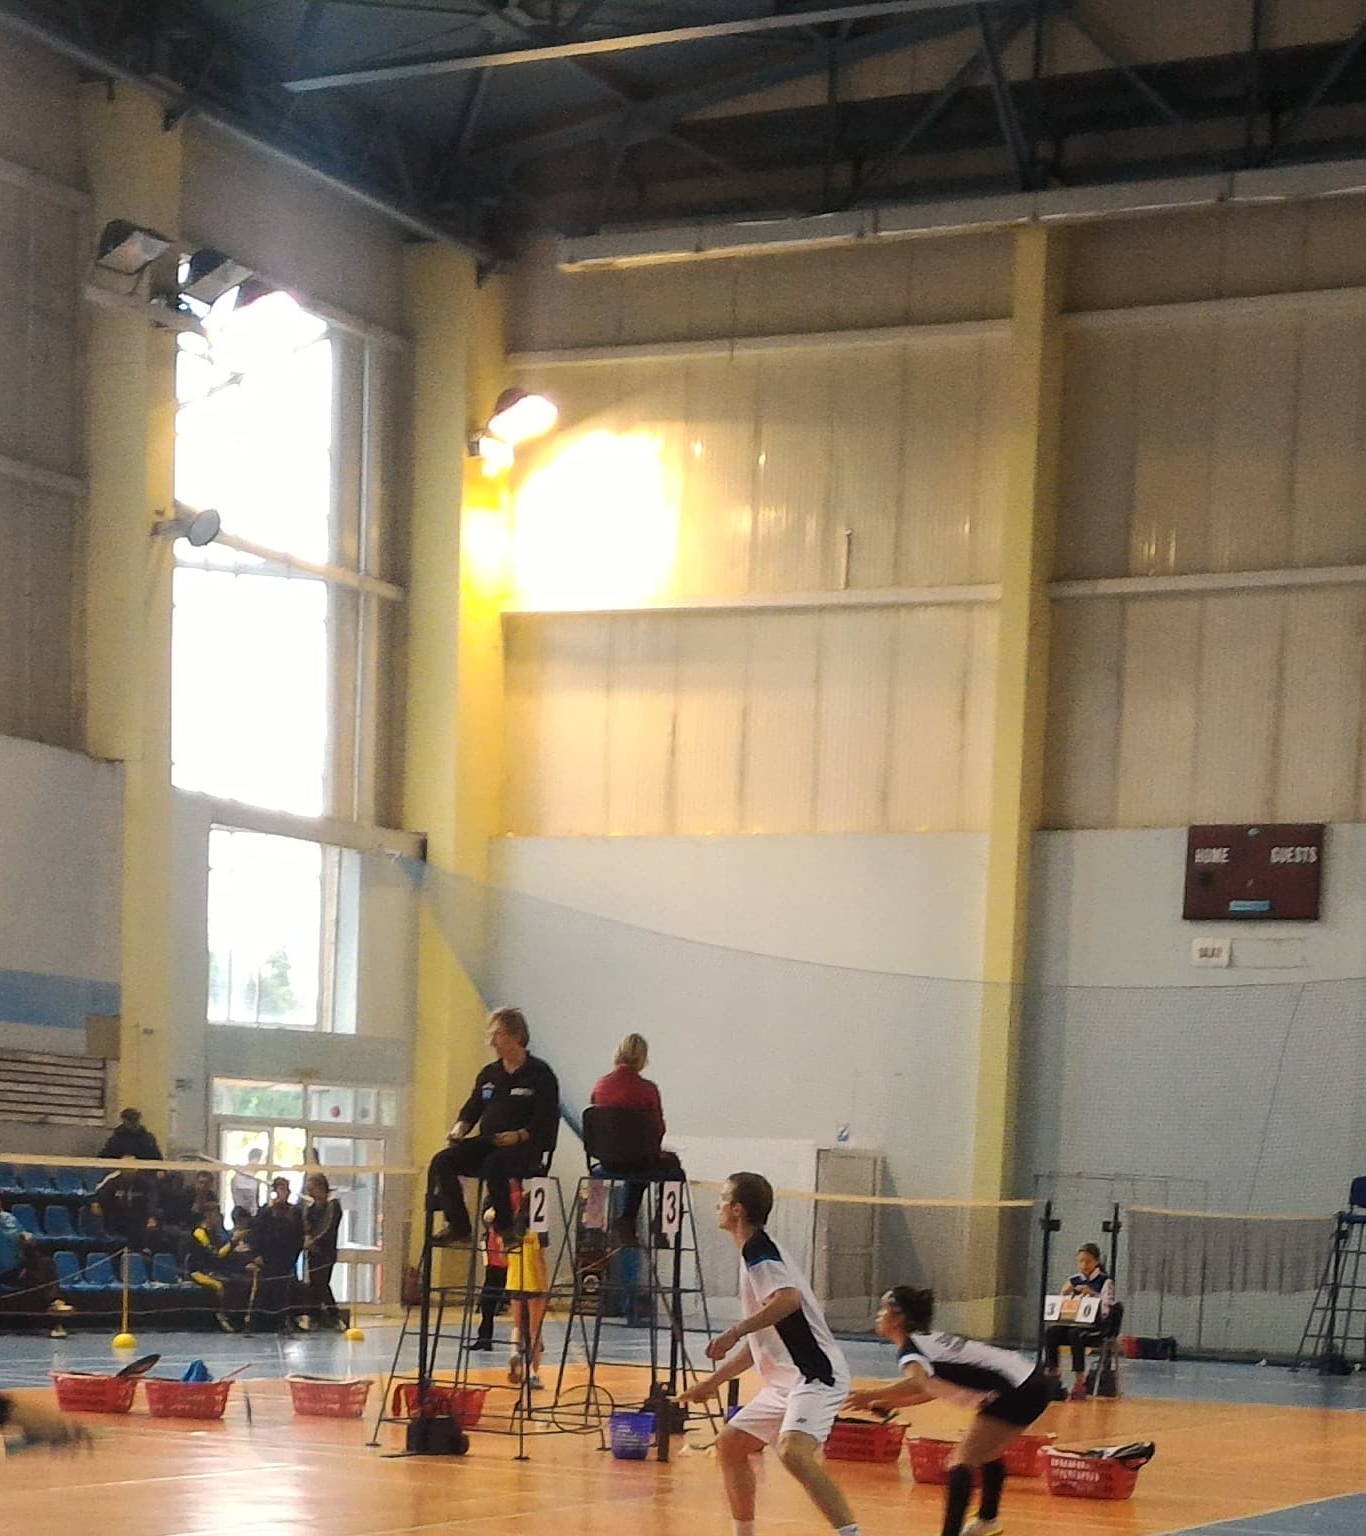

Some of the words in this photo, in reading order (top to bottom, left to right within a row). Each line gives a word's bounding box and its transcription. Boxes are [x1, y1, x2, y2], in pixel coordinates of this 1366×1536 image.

[1194, 847, 1231, 864] HOME
[1270, 846, 1318, 864] GUESTS
[533, 1187, 546, 1223] 2
[666, 1190, 677, 1224] 3
